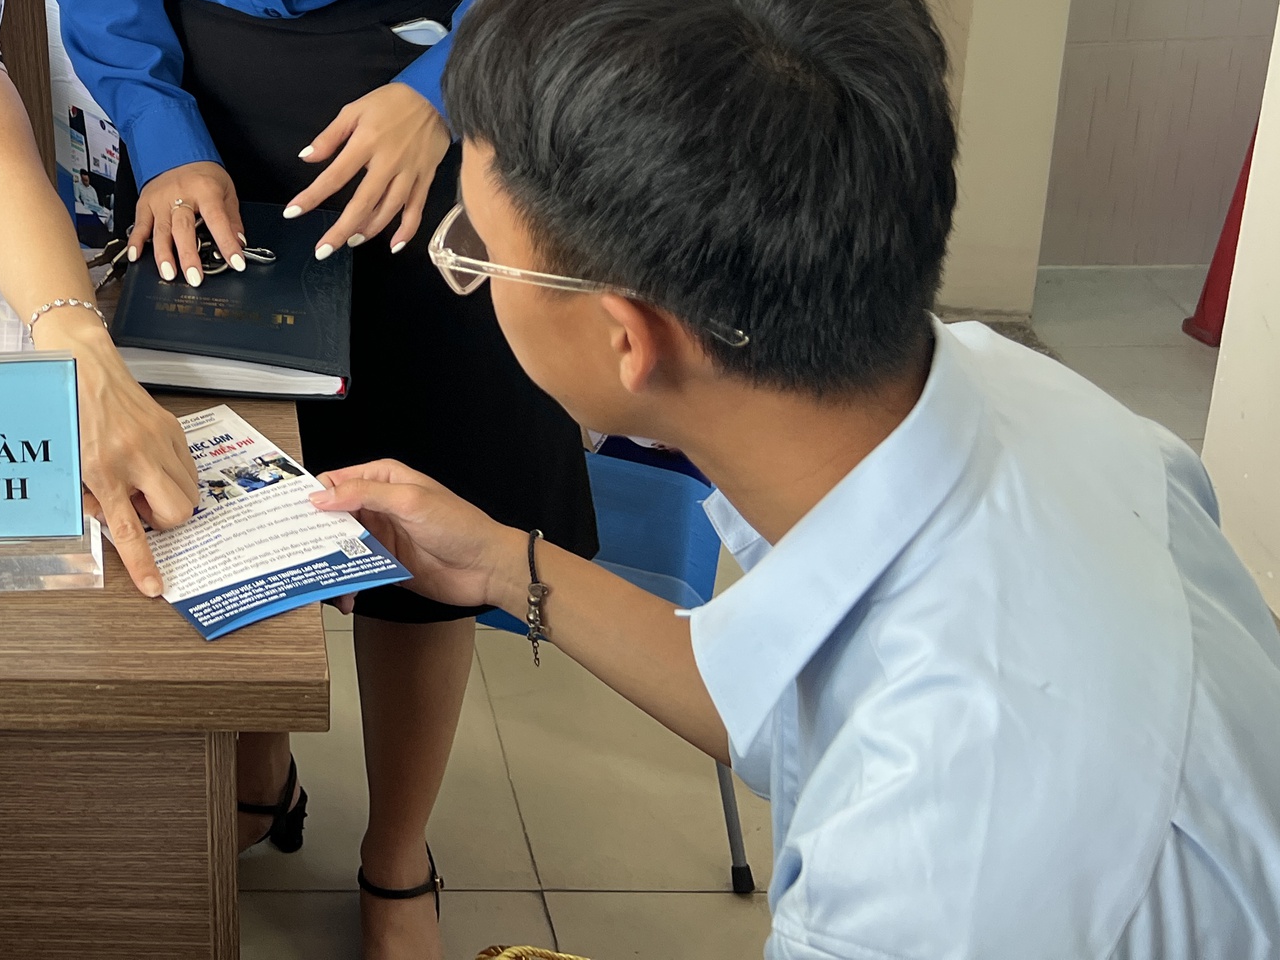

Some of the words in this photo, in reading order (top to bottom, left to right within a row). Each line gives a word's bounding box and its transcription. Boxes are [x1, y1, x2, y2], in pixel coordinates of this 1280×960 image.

[207, 433, 234, 446] LÀM
[209, 444, 237, 458] MIỄN
[236, 436, 255, 449] PHÍ
